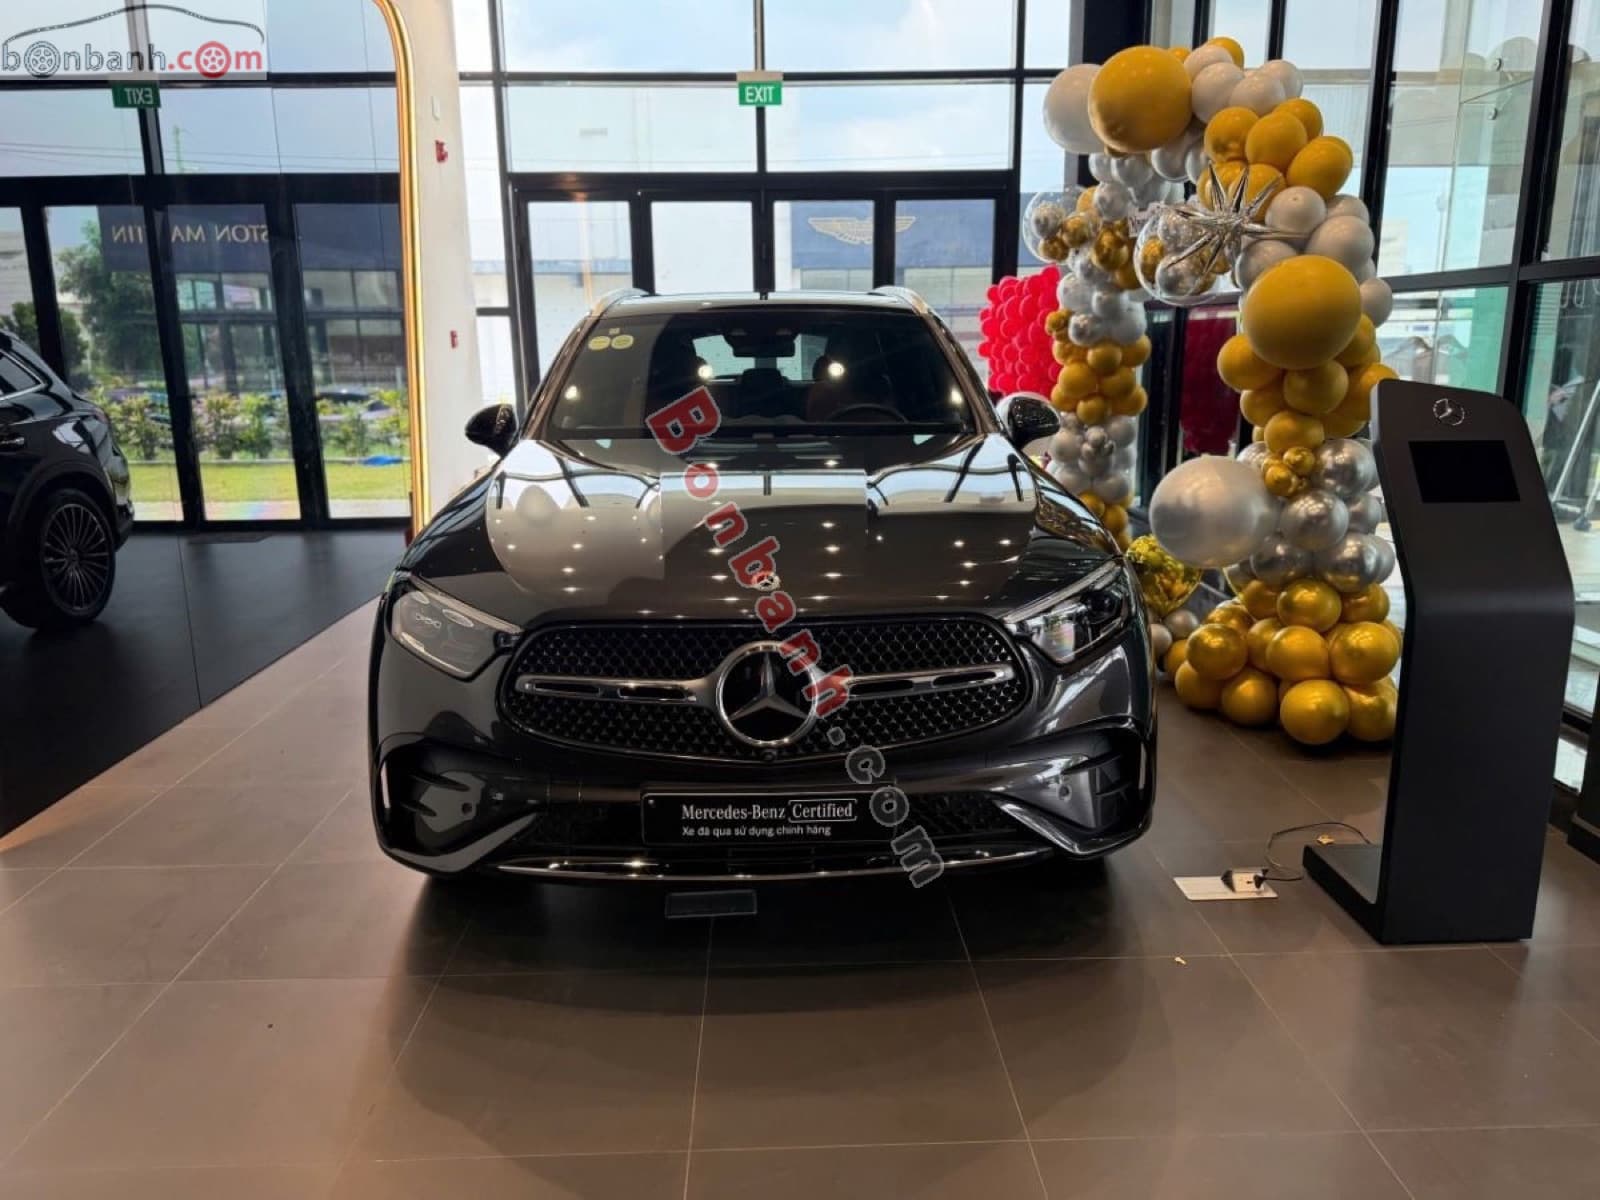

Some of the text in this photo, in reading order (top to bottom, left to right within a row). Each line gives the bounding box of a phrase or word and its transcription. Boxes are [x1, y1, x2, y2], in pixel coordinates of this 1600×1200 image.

[745, 86, 775, 103] EXIT
[681, 803, 853, 820] Mercedes-Benz Certified
[682, 826, 695, 836] Xe
[712, 827, 731, 838] qua
